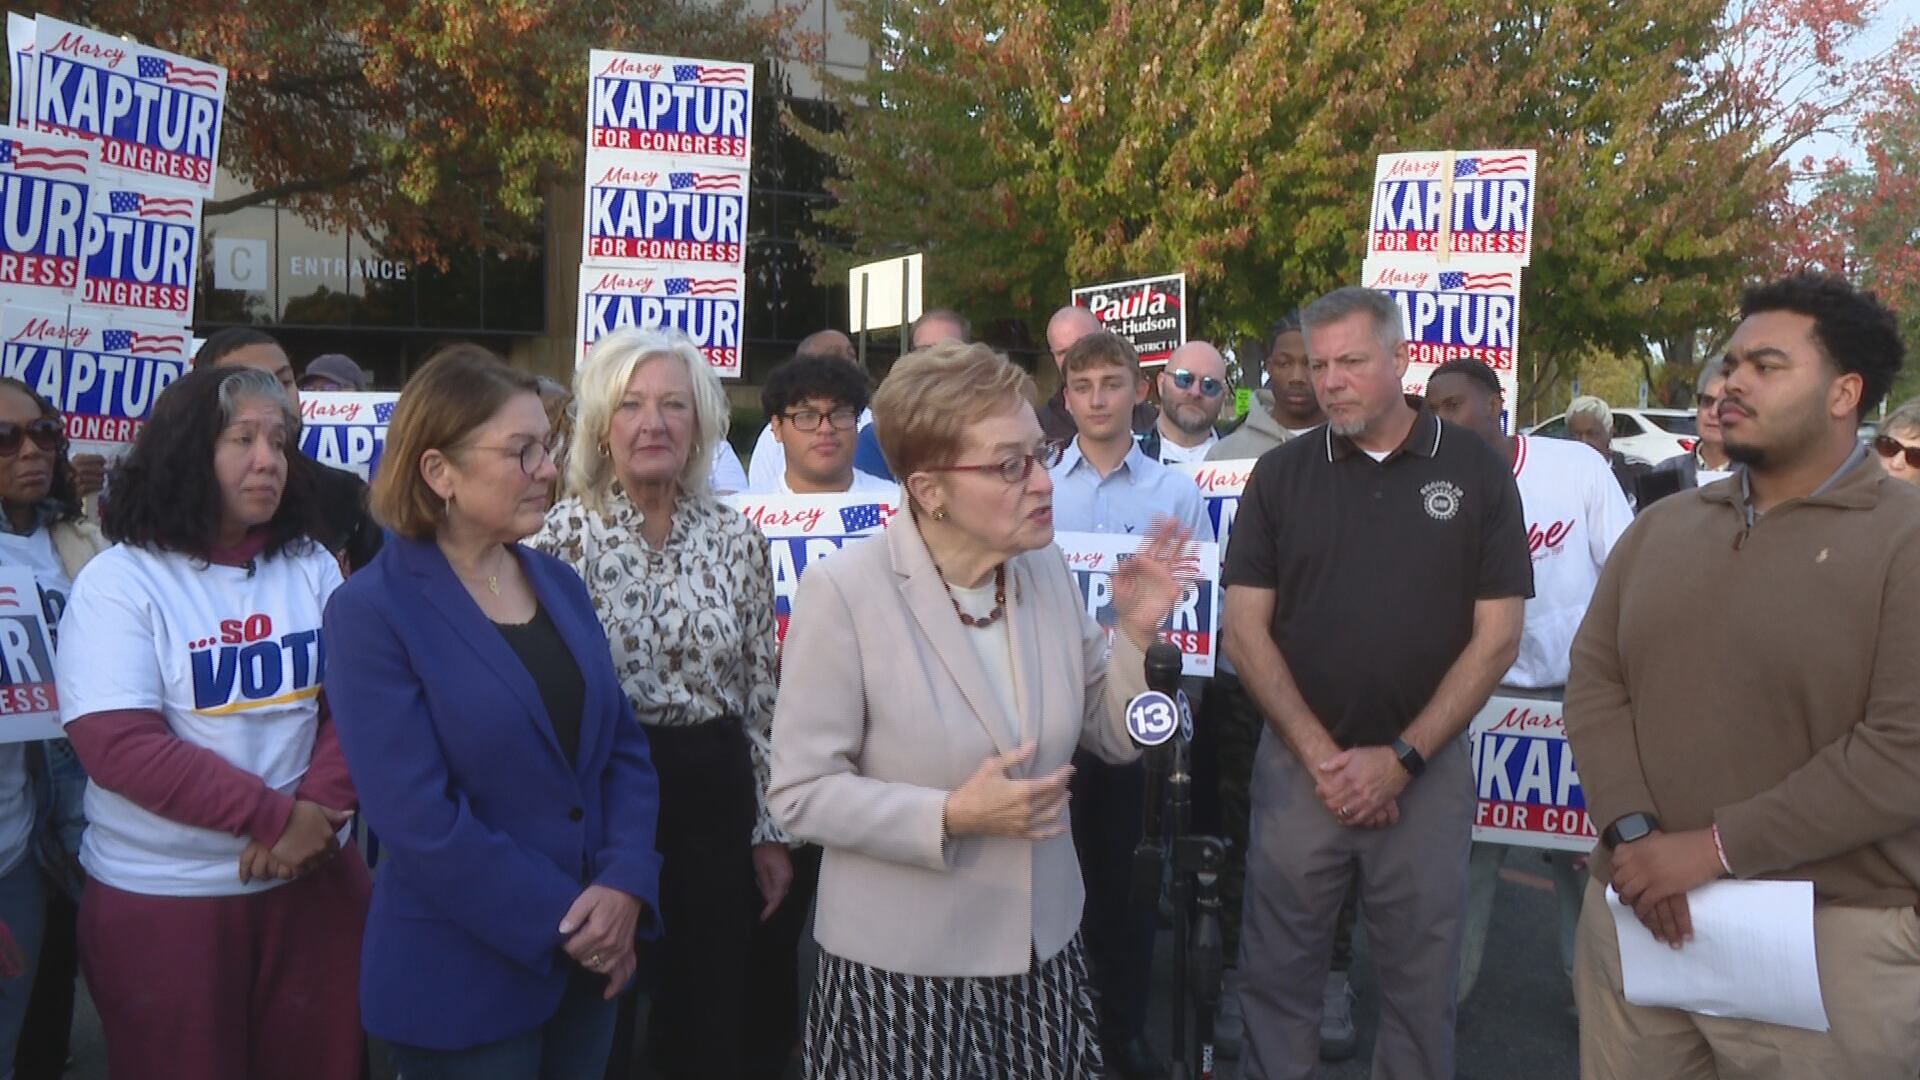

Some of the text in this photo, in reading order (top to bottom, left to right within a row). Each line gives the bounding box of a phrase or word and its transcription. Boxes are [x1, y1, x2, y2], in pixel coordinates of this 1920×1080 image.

[46, 32, 125, 69] Marcy
[597, 57, 663, 79] Marcy
[38, 54, 214, 158] KAPTUR
[594, 78, 745, 137] KAPTUR
[593, 128, 744, 156] FOR CONGRESS
[100, 139, 209, 182] ONGRESS
[1383, 158, 1440, 180] Marcy
[595, 166, 659, 188] Marcy
[591, 187, 740, 243] KAPTUR
[590, 238, 739, 262] FOR CONGRESS
[1375, 231, 1408, 251] FOR
[230, 246, 407, 281] C ENTRANCE
[1370, 267, 1429, 288] Marcy
[590, 272, 654, 294] Marcy
[1089, 284, 1167, 322] Paula
[10, 318, 91, 347] Marcy
[1131, 701, 1173, 735] 13
[1476, 802, 1529, 829] FOR
